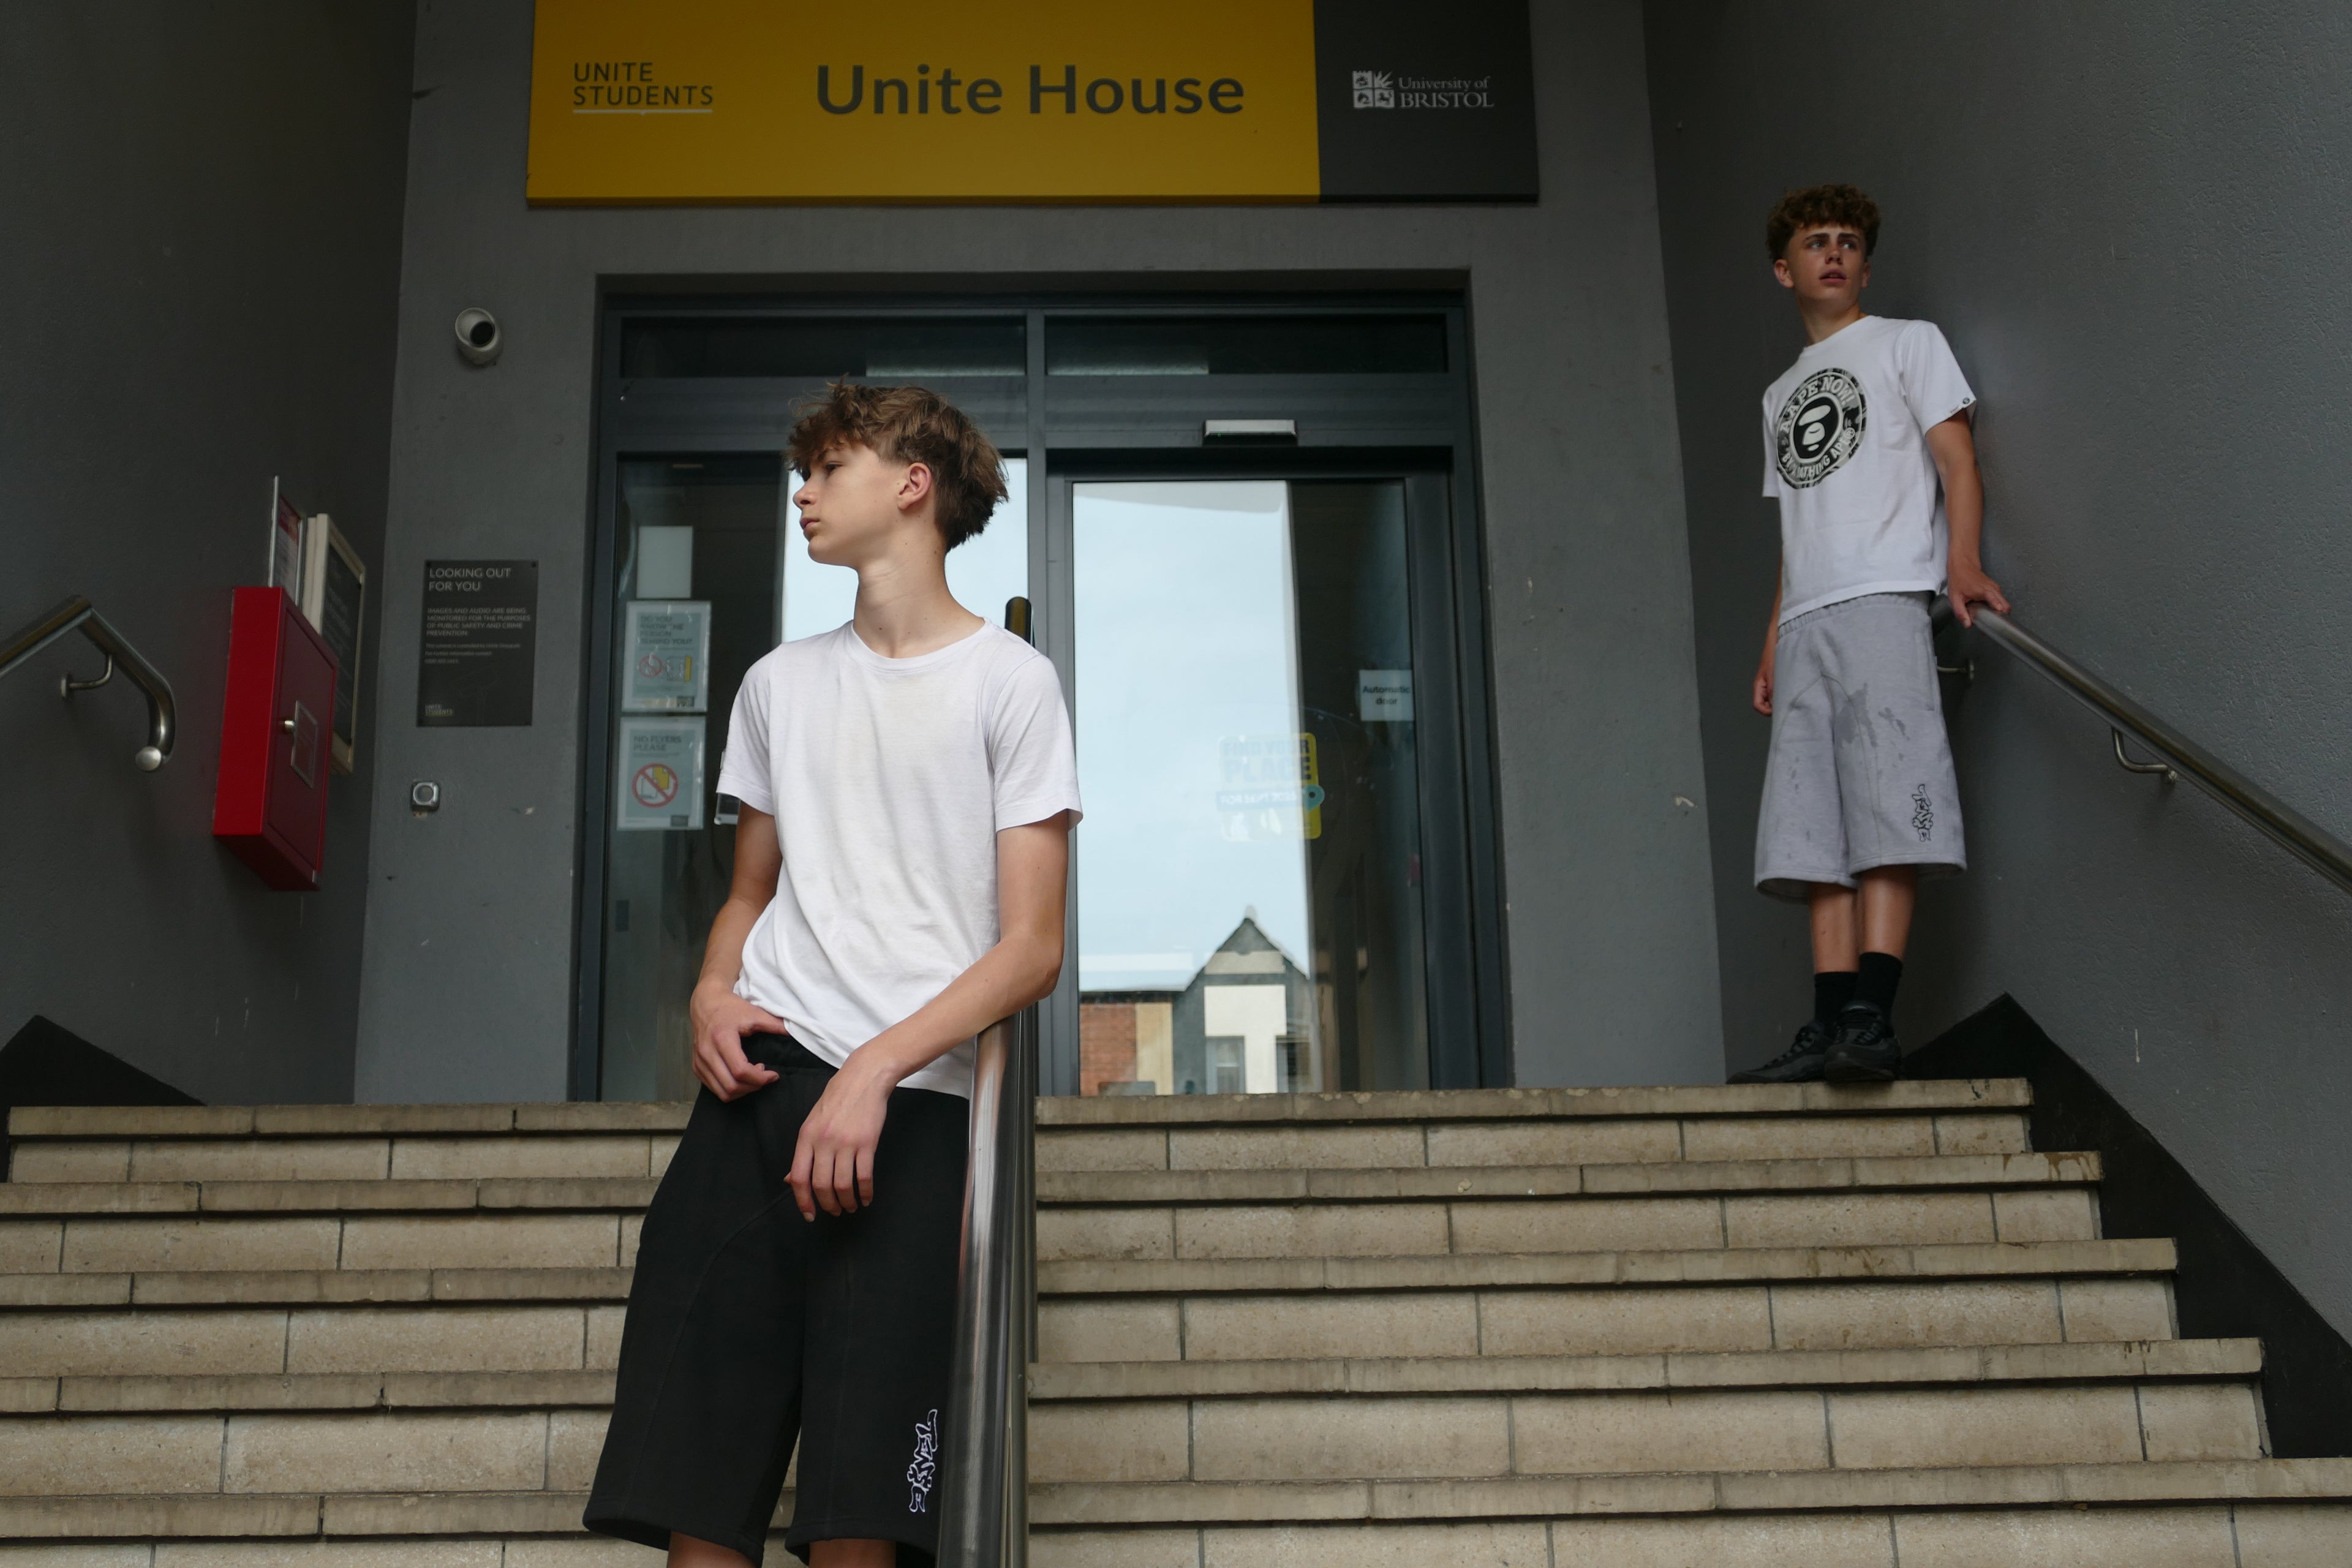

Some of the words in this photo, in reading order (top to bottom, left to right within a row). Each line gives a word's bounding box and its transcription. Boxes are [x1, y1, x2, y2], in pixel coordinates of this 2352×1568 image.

[573, 62, 653, 82] UNITE
[816, 62, 1003, 115] Unite
[1029, 64, 1245, 115] House
[1398, 76, 1471, 92] University
[1474, 75, 1491, 89] of
[573, 85, 714, 105] STUDENTS
[1400, 92, 1495, 108] BRISTOL
[1780, 379, 1819, 434] AAPE
[429, 567, 483, 579] LOOKING
[486, 567, 511, 579] OUT
[429, 581, 453, 592] FOR
[455, 581, 480, 592] YOU
[1363, 685, 1411, 693] Automatic
[650, 734, 682, 743] FLYERS
